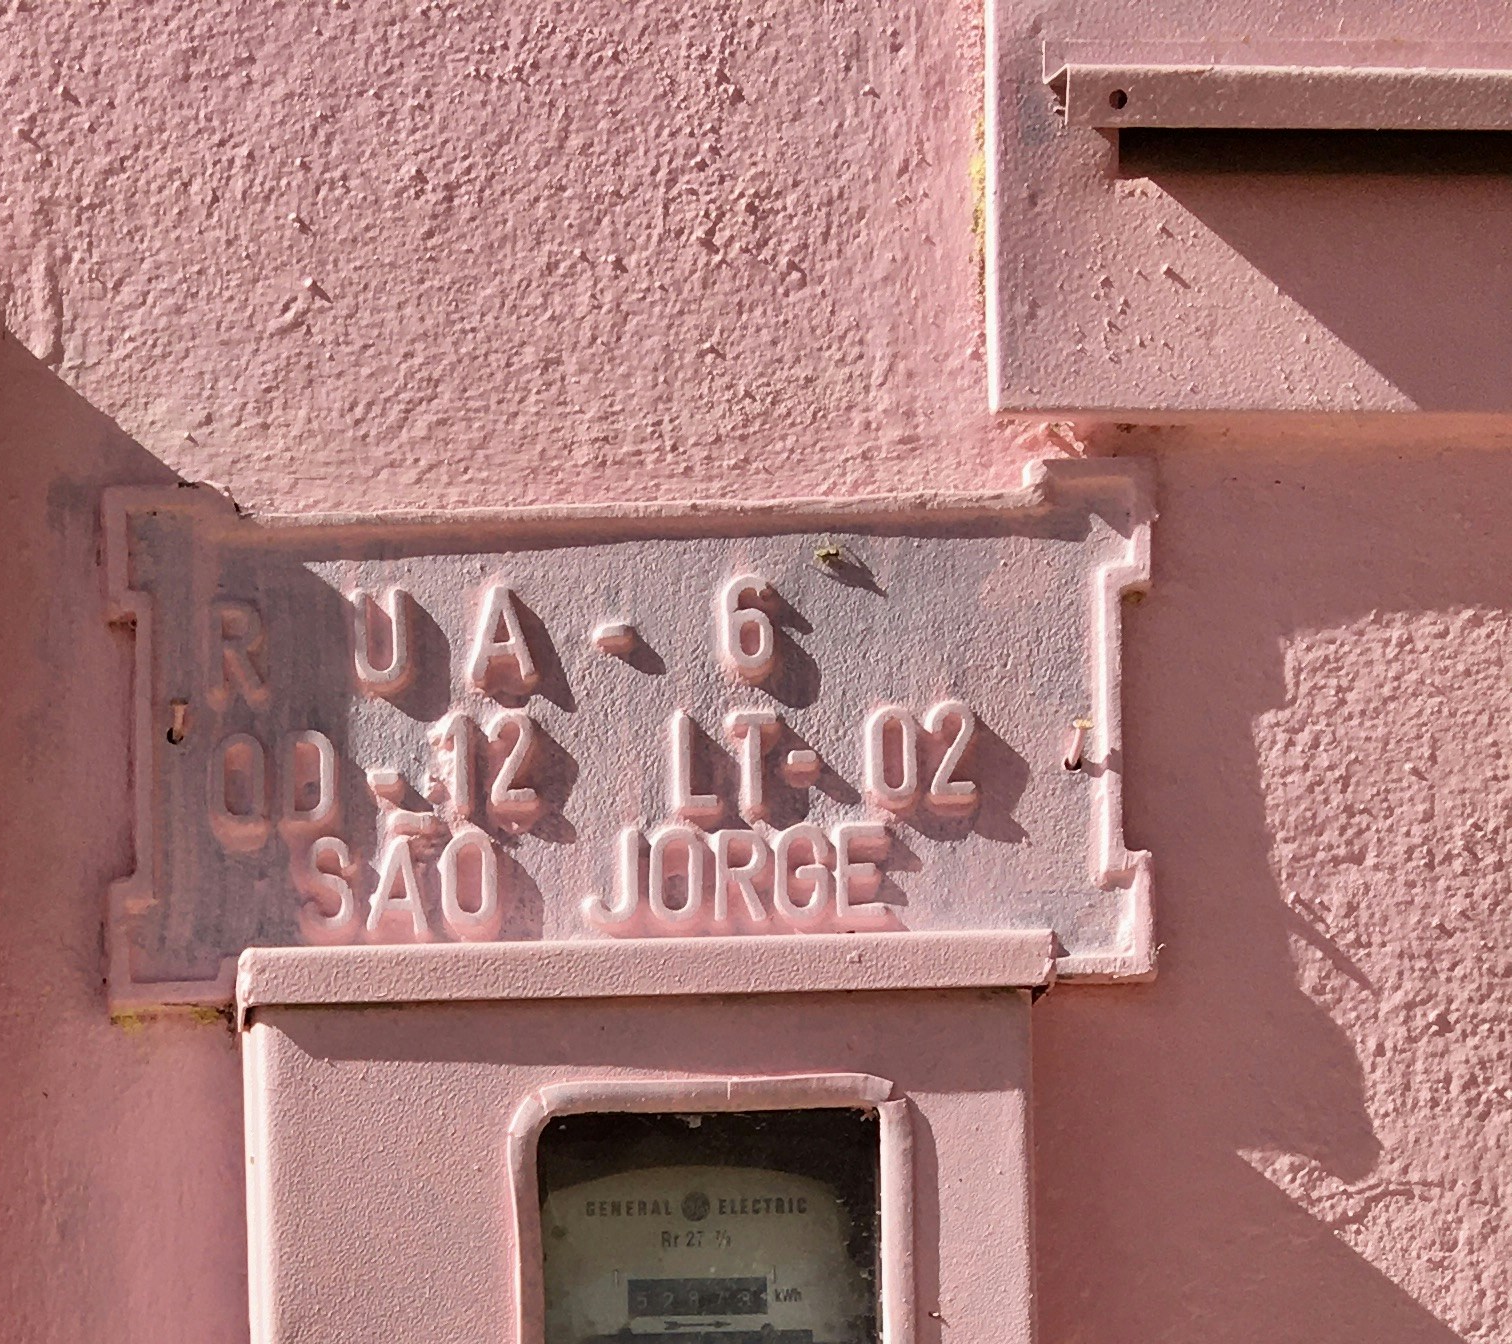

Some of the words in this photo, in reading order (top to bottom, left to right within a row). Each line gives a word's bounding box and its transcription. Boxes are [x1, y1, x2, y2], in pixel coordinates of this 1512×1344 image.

[584, 822, 890, 923] JORGE
[585, 1199, 672, 1217] GENERAL
[718, 1197, 808, 1215] ELECTRIC
